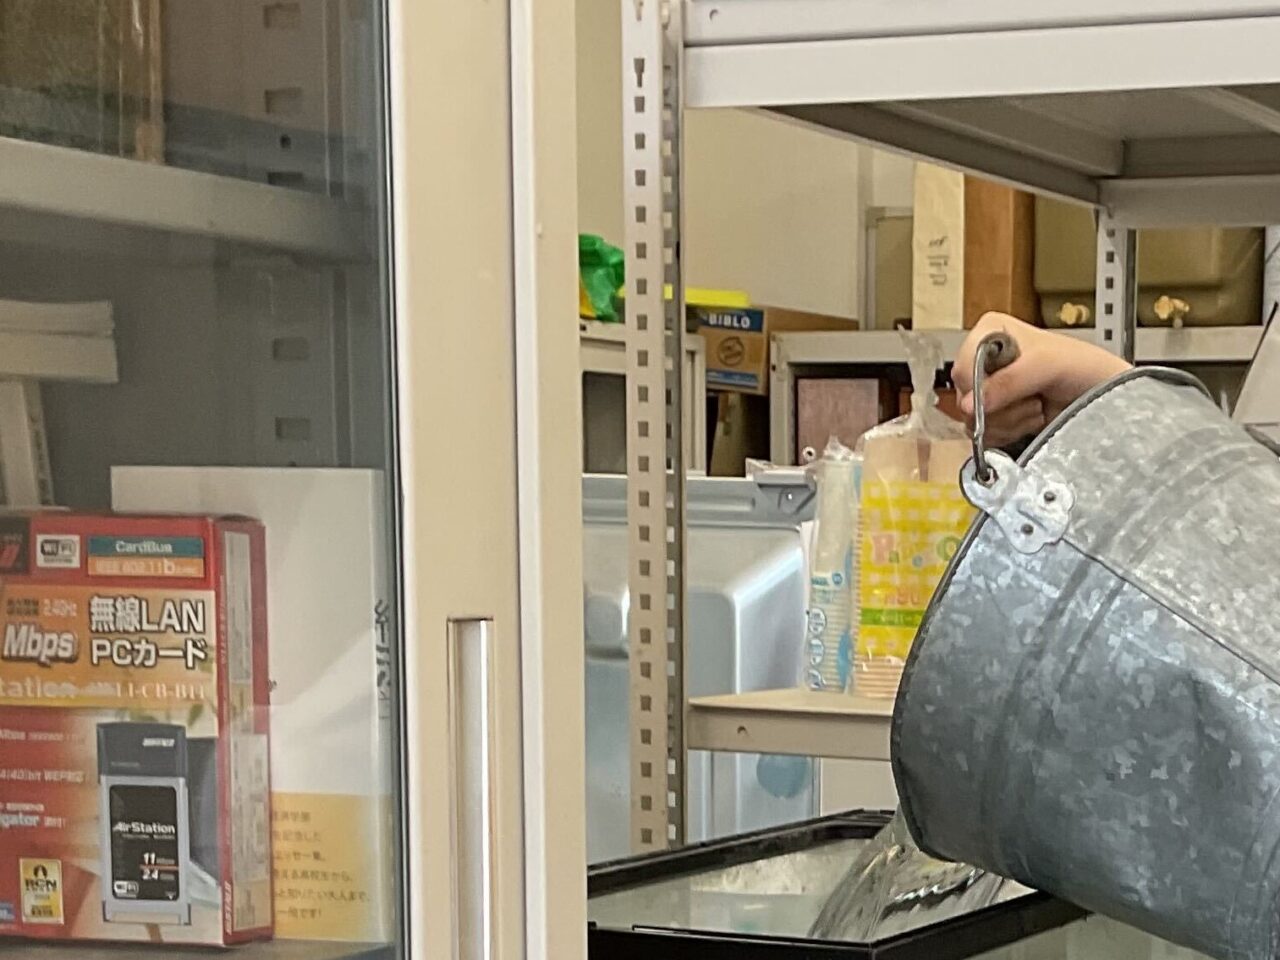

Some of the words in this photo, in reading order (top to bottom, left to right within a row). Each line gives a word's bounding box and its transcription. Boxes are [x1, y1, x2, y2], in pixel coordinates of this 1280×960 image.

[90, 596, 205, 632] 無線LAN
[3, 623, 76, 667] Mbps
[91, 639, 207, 669] PCカード
[112, 821, 175, 834] AirStation
